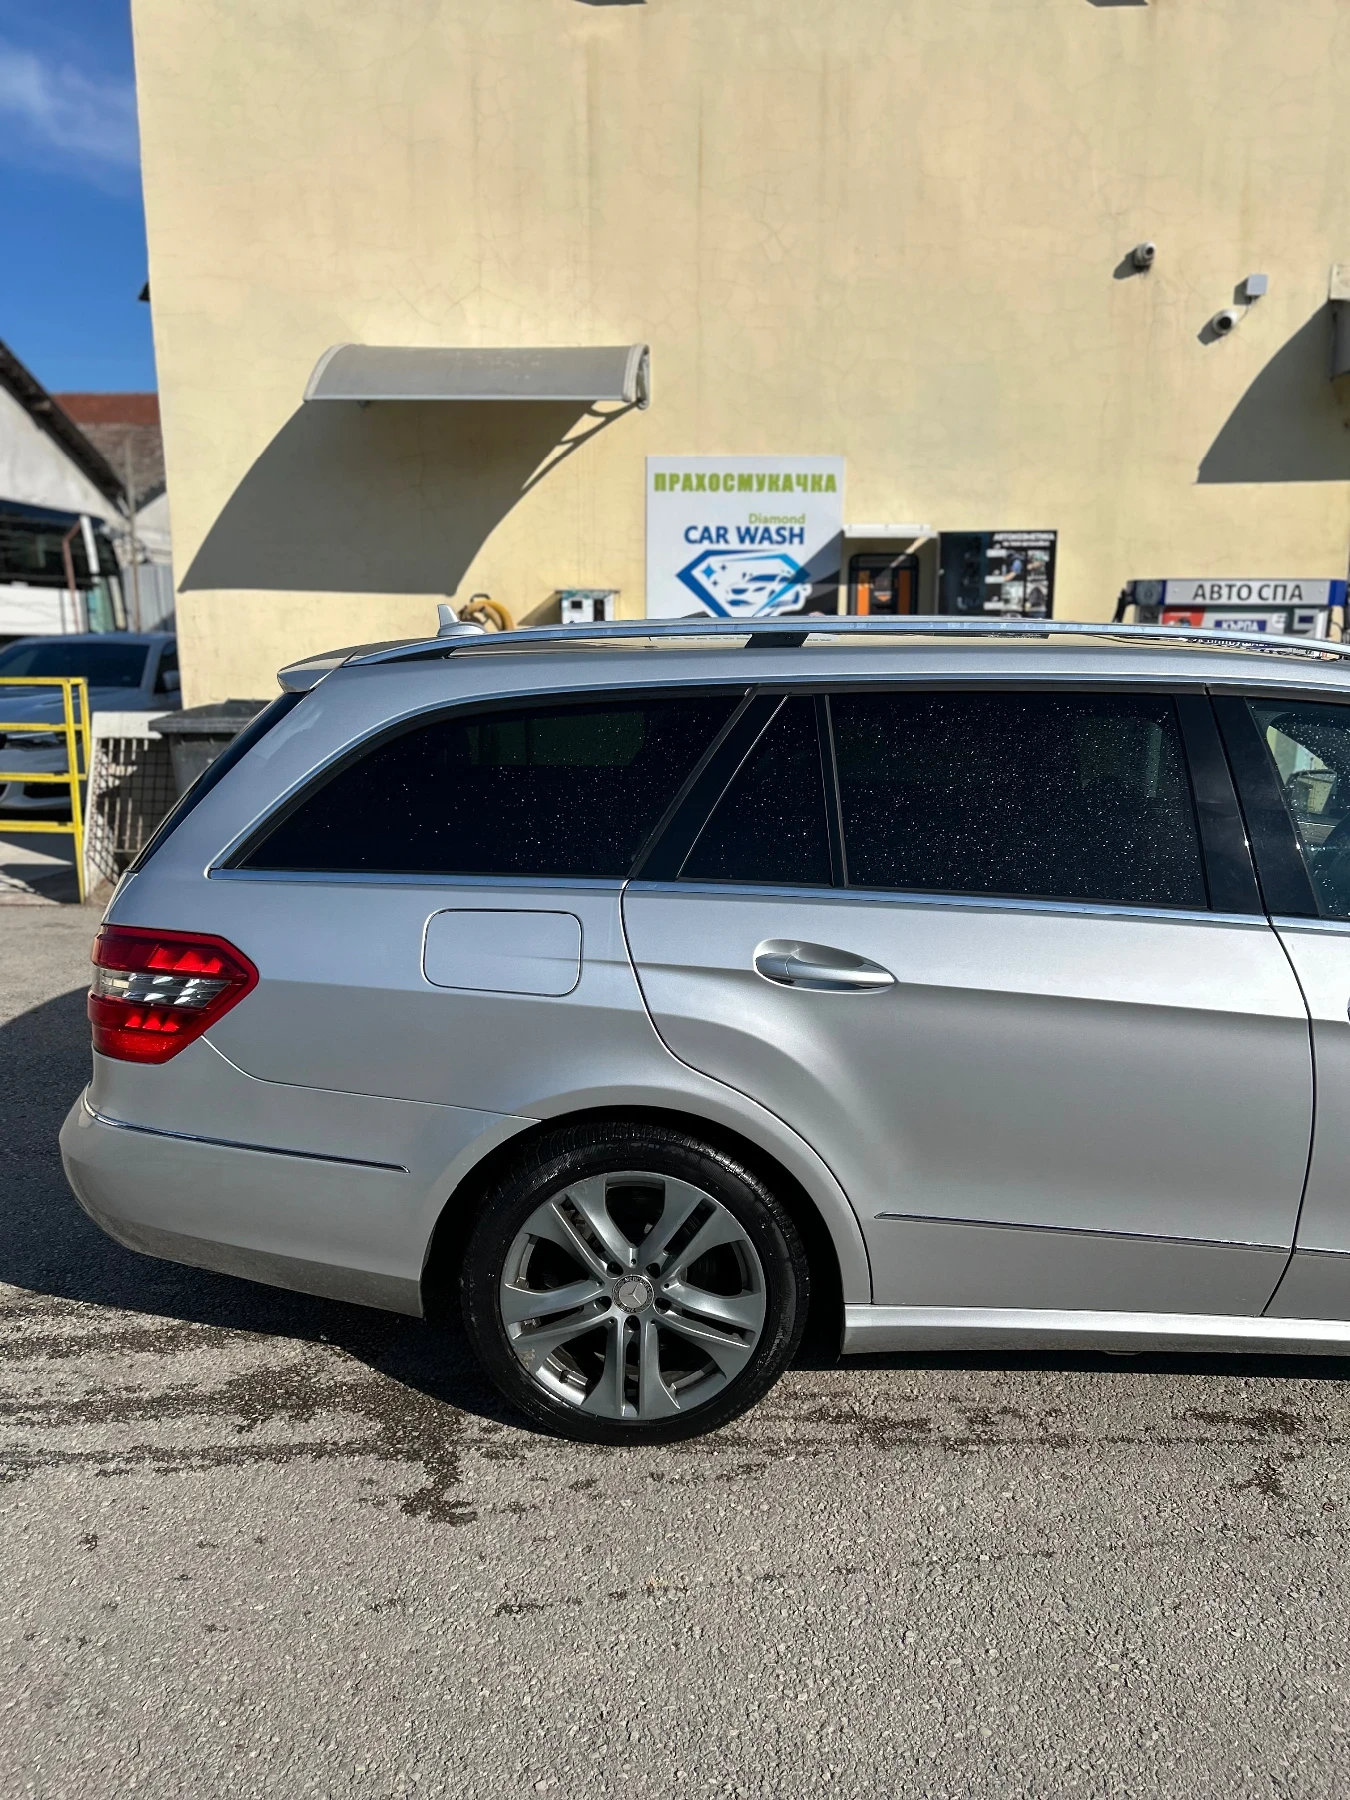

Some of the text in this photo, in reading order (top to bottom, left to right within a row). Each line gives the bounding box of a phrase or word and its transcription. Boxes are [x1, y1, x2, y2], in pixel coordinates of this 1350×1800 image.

[654, 473, 837, 493] ПРАХОСМУКАЧКА
[749, 513, 806, 525] Diamond
[684, 525, 805, 545] CAR WASH
[1192, 584, 1304, 602] АВТО СПА
